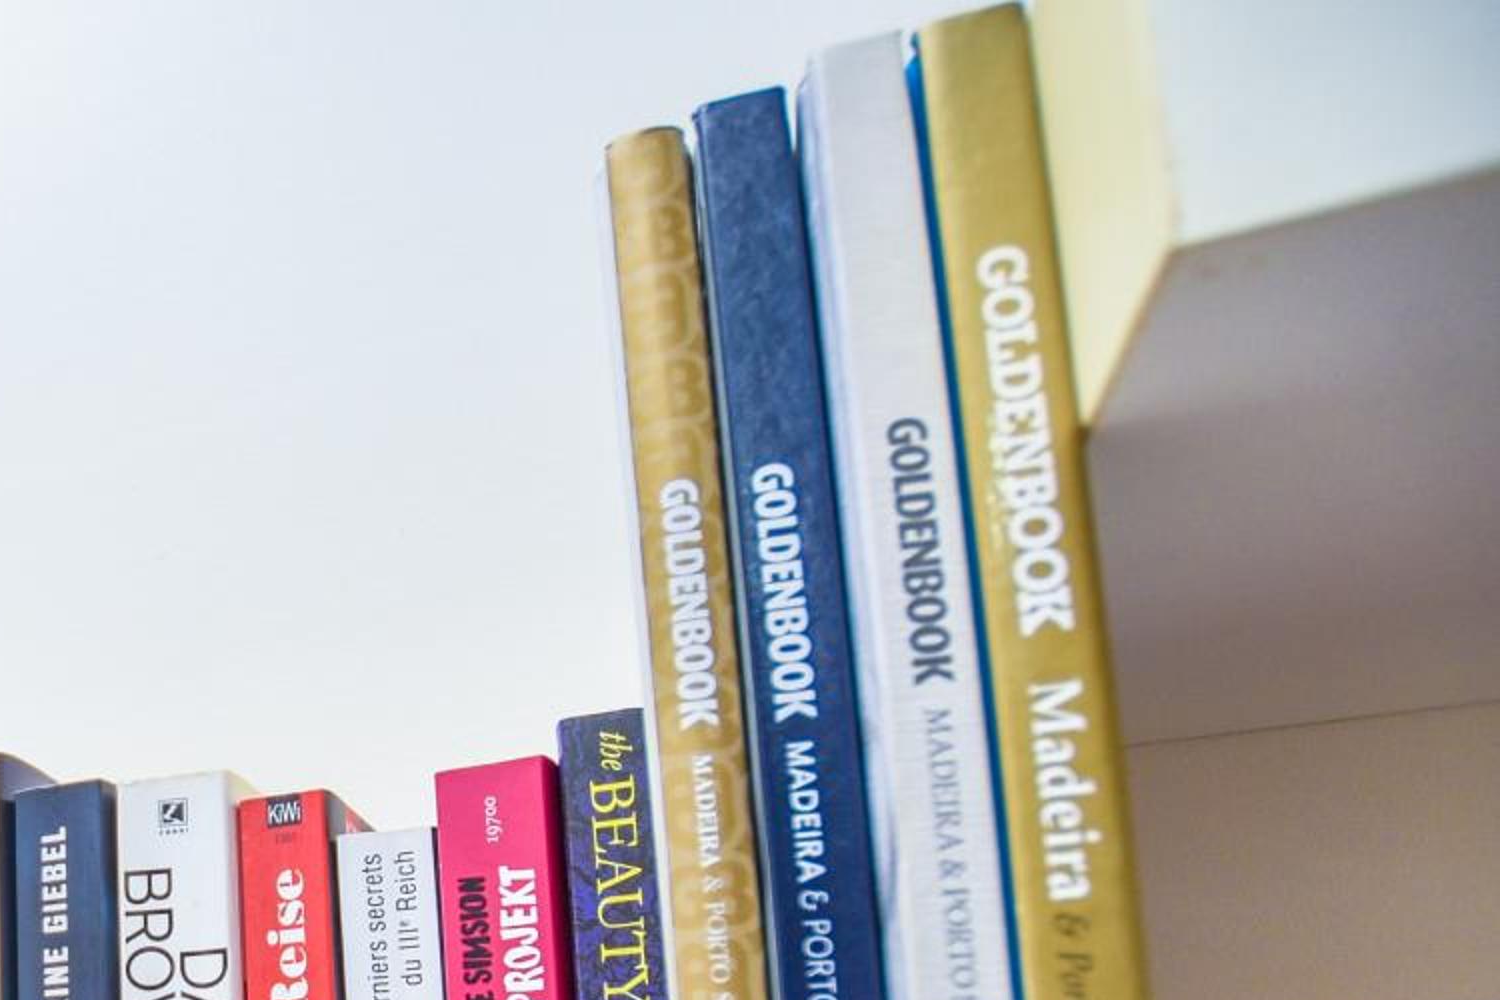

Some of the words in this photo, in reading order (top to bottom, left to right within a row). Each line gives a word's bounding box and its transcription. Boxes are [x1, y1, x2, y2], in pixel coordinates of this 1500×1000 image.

[976, 244, 1078, 640] GOLDENBOOK
[659, 479, 720, 732] GOLDENBOOK
[888, 417, 956, 686] GOLDENBOOK
[752, 461, 818, 725] GOLDENBOOK
[786, 741, 827, 885] MADEIRA
[600, 731, 633, 772] the
[924, 708, 966, 851] MADEIRA
[1026, 677, 1102, 903] Madeira
[690, 754, 723, 869] MADEIRA
[40, 826, 70, 934] GIEBEL
[362, 853, 387, 932] secrets
[394, 850, 418, 911] Reich
[703, 875, 726, 894] &
[938, 858, 967, 880] &
[401, 958, 424, 988] du
[458, 876, 493, 985] SIMSION
[707, 903, 734, 986] PORTO
[942, 887, 978, 991] PORTO
